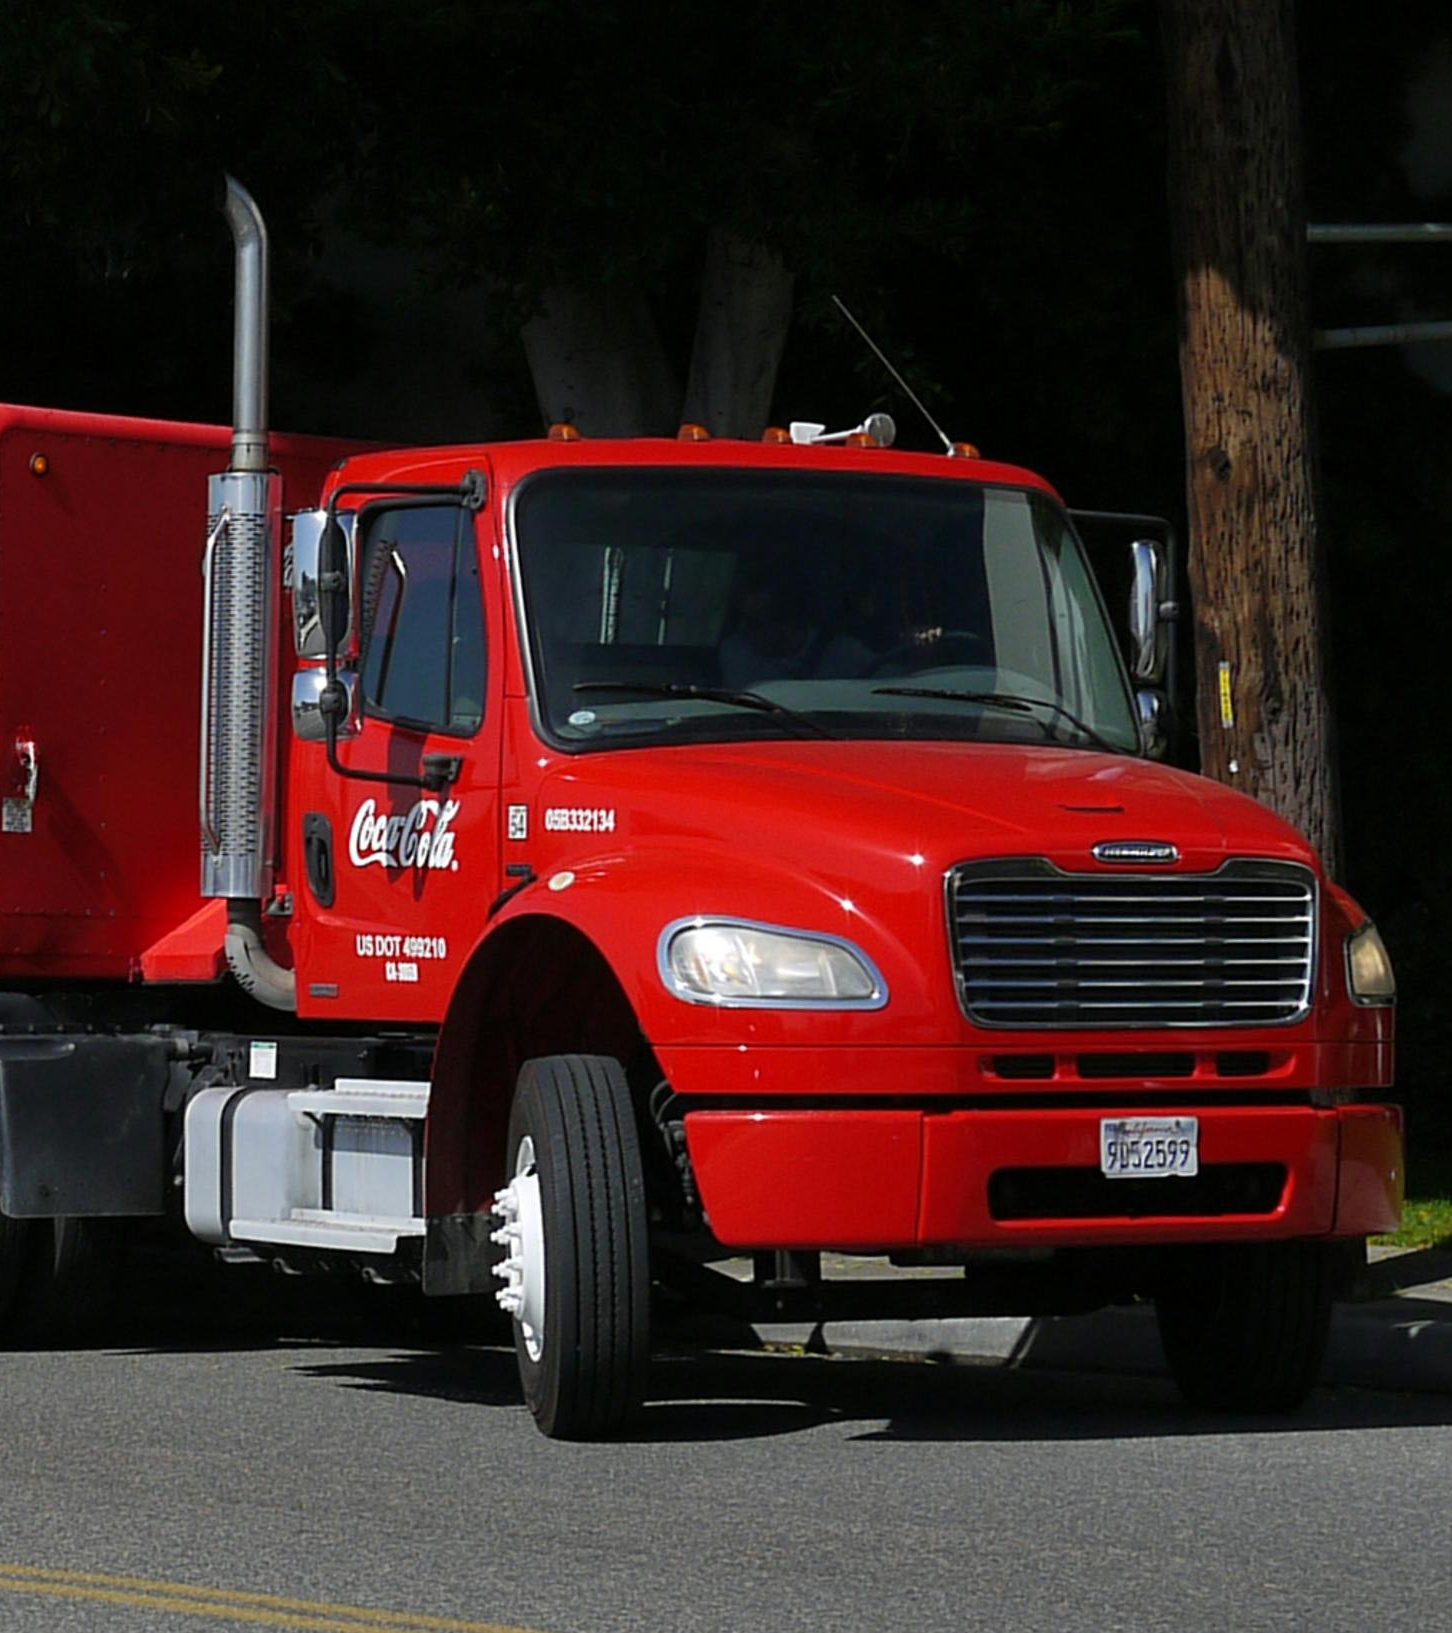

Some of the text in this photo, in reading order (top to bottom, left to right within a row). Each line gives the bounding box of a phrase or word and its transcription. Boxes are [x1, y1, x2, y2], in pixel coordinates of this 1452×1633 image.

[349, 799, 460, 869] Coca-Cola
[356, 934, 374, 957] US
[375, 935, 402, 957] DOT
